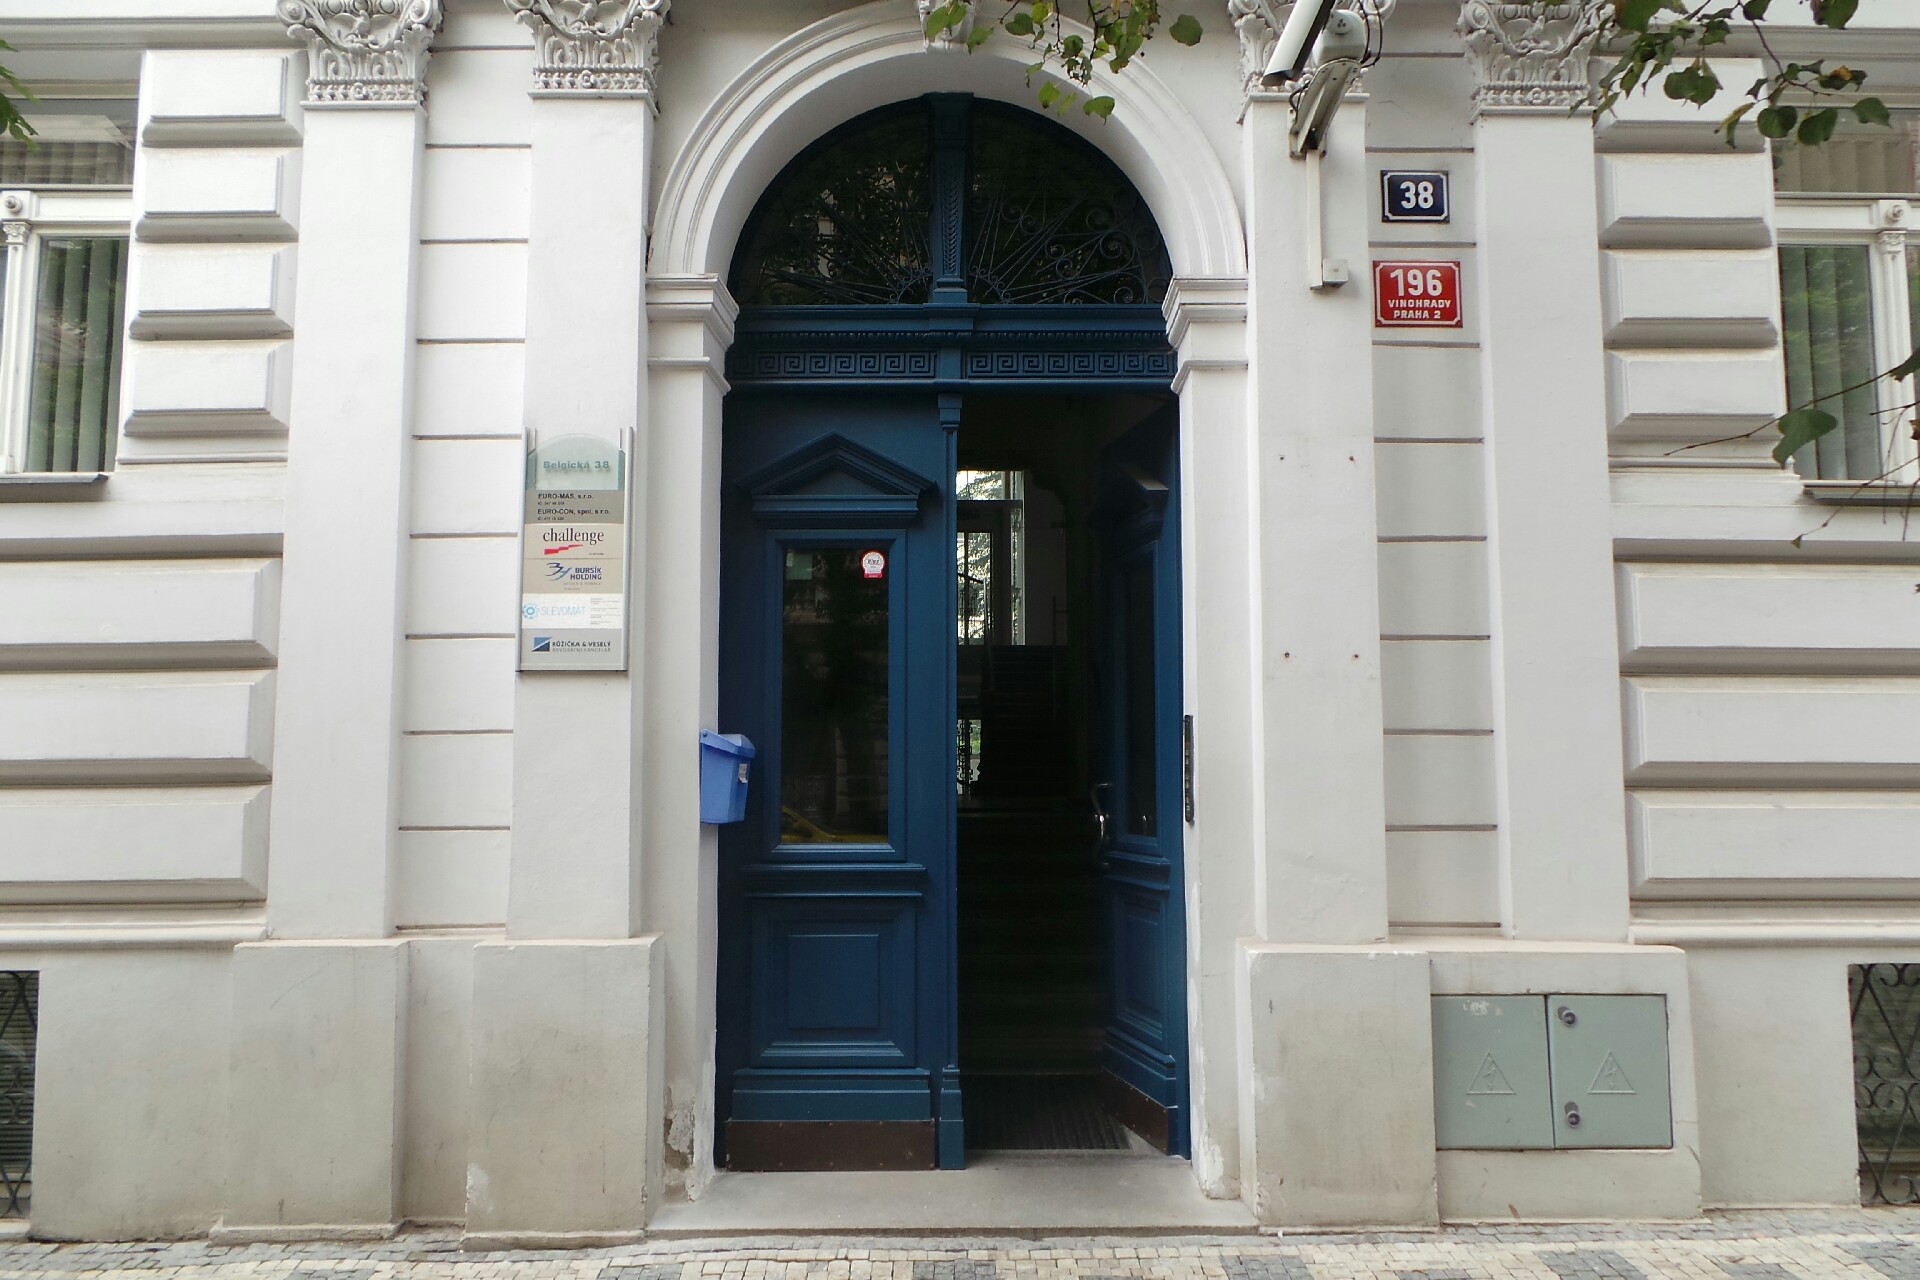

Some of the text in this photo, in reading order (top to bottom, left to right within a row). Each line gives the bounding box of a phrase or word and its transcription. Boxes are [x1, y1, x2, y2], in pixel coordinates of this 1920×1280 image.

[1400, 181, 1434, 209] 38
[1390, 269, 1443, 297] 196
[1388, 299, 1451, 308] VINOHRADY
[1393, 310, 1441, 319] PRAHA 2
[543, 461, 610, 470] Belgická 38
[543, 528, 604, 545] challenge
[541, 606, 586, 616] SLEVOMAT
